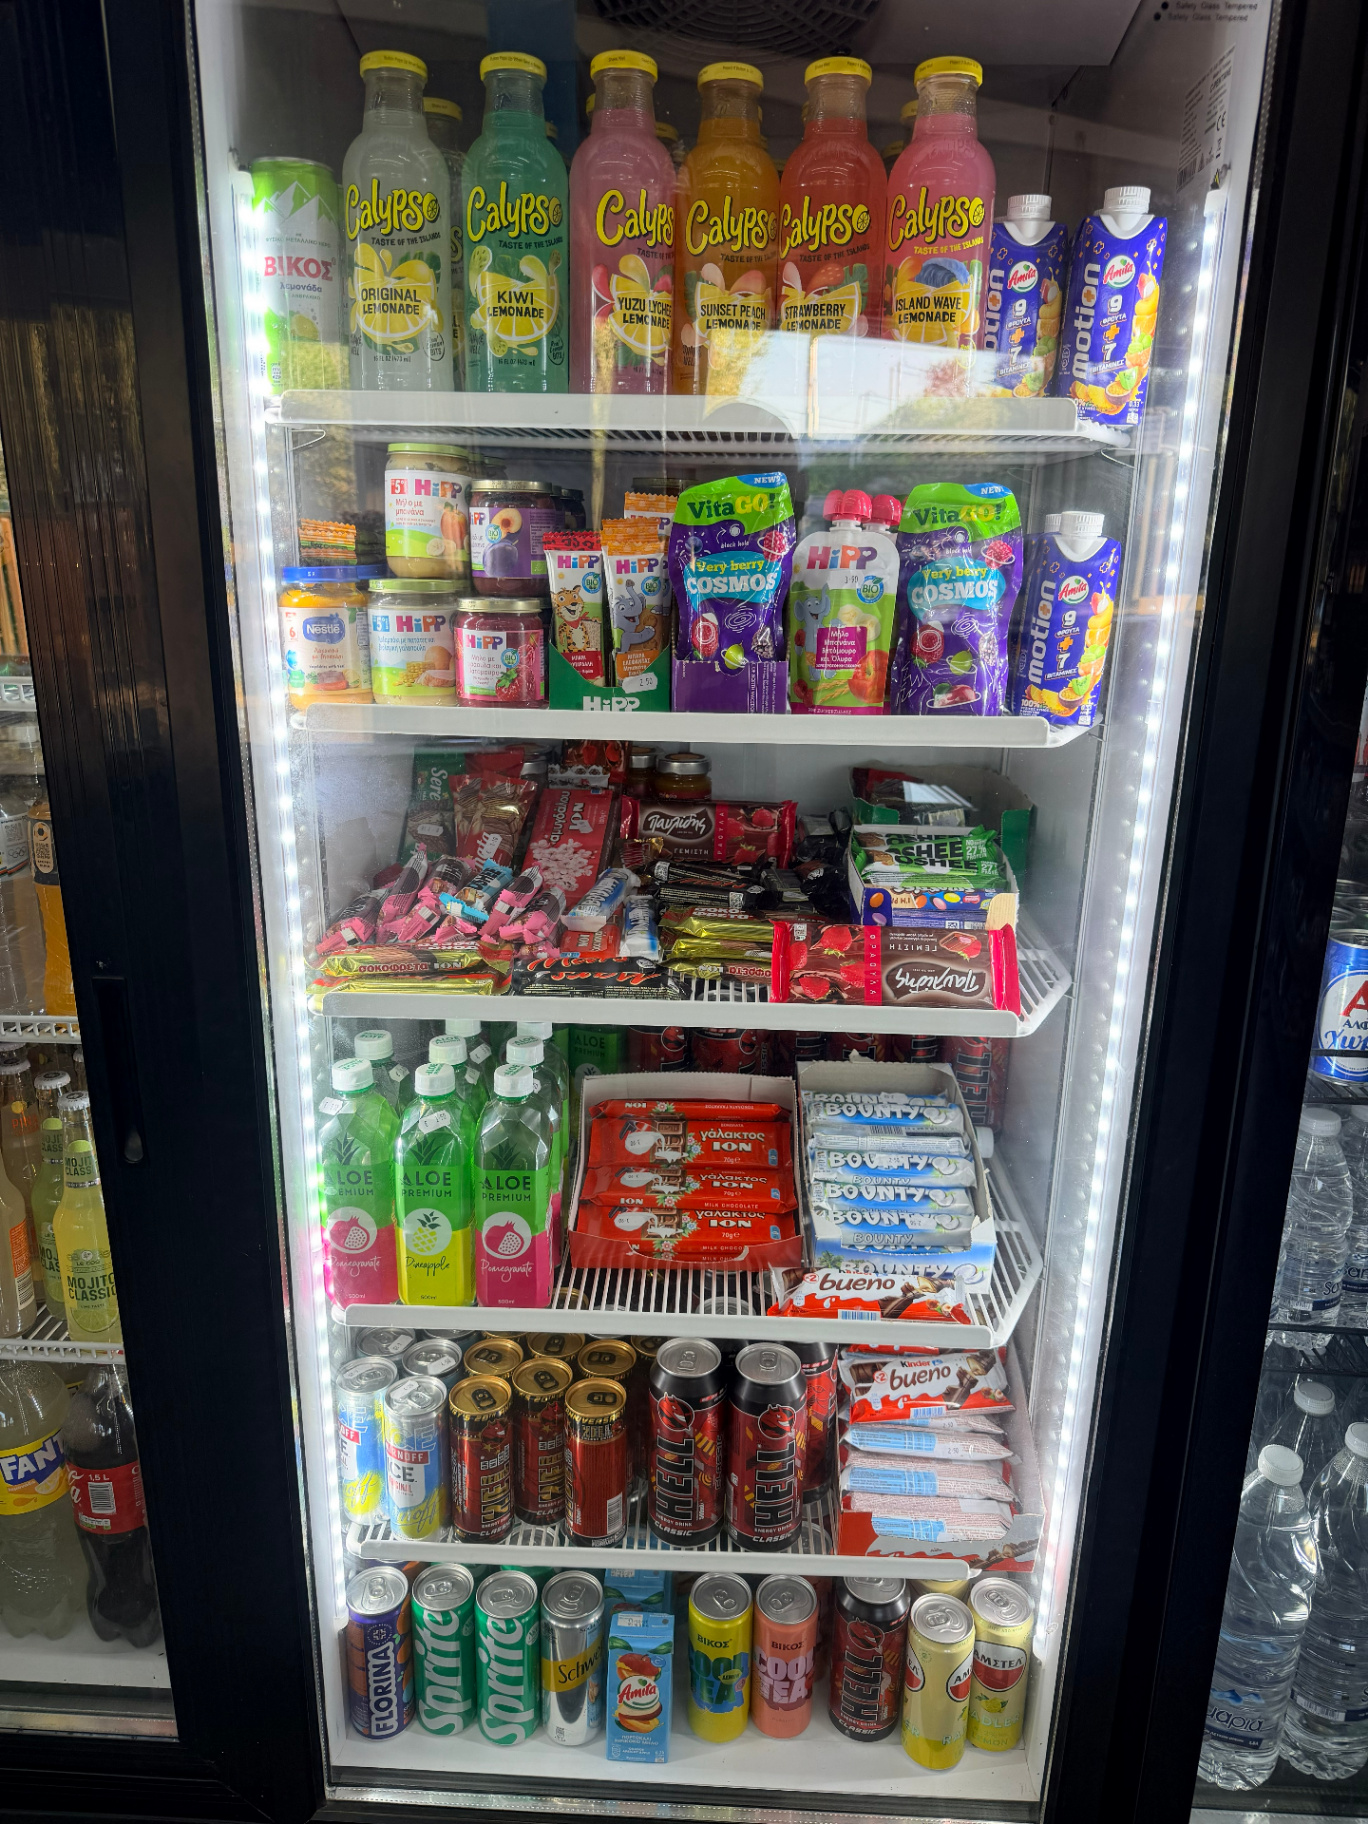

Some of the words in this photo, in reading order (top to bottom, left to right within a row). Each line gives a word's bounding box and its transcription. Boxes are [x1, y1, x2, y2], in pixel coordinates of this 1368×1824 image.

[1225, 1, 1257, 10] Tempered
[346, 179, 441, 241] Calypso
[466, 181, 563, 242] Calypso
[596, 188, 674, 247] Calyps
[888, 186, 985, 251] Calypso
[779, 195, 871, 259] Calypso
[371, 236, 395, 246] TASTE
[408, 237, 418, 245] THE
[499, 240, 523, 250] TASTE
[913, 245, 937, 255] TASTE
[938, 244, 948, 253] OF
[950, 243, 961, 252] THE
[961, 236, 984, 251] ISLANDS
[799, 254, 821, 263] TASTE
[264, 256, 333, 281] ΒΙΚΟΣ
[1103, 262, 1134, 285] Amita
[1007, 267, 1038, 290] Amita
[280, 281, 322, 293] λεμονάδα
[361, 288, 421, 303] ORIGINAL
[497, 291, 534, 304] KIWI
[363, 303, 420, 315] LEMONADE
[618, 297, 646, 311] YUZU
[648, 299, 672, 318] LYCHEE
[700, 303, 737, 318] SUNSET
[740, 305, 766, 319] PEACH
[784, 303, 846, 319] STRAWBERRY
[895, 296, 930, 312] ISLAND
[933, 296, 962, 311] WAVE
[1013, 299, 1027, 318] 9
[1109, 295, 1123, 315] 9
[488, 306, 544, 319] LEMONADE
[898, 311, 956, 325] LEMONADE
[1101, 313, 1127, 327] ΦΡΟΥΤΑ
[622, 313, 670, 330] LEMONADE
[706, 319, 761, 331] LEMONADE
[786, 319, 841, 331] LEMONADE
[1007, 316, 1031, 328] ΦΡΟΥΤΑ
[1072, 263, 1100, 380] motion
[1010, 345, 1021, 366] 7
[1104, 343, 1117, 363] 7
[1092, 360, 1125, 374] ΒΙΤΑΜΙΝΕΣ
[415, 479, 462, 499] HiPP
[980, 486, 1004, 495] NEW!
[396, 508, 424, 516] μπανάνα
[687, 493, 776, 519] VitaGO!
[913, 503, 1001, 526] VitaGO!
[557, 555, 600, 569] HiPP
[807, 546, 878, 570] HiPP
[616, 558, 659, 575] HiPP
[696, 560, 727, 573] Very
[730, 560, 765, 571] berry
[922, 567, 950, 580] Very
[955, 564, 986, 579] berry
[586, 578, 598, 586] BIO
[645, 582, 658, 590] BIO
[687, 573, 778, 595] COSMOS
[861, 584, 879, 594] BIO
[912, 580, 998, 603] COSMOS
[1058, 581, 1087, 601] Amita
[396, 615, 446, 632] HiPP
[1063, 610, 1077, 627] 9
[289, 627, 296, 638] 6
[831, 630, 849, 638] Μήλο
[1028, 580, 1056, 684] motion
[1055, 627, 1080, 637] ΦΡΟΥΤΑ
[465, 634, 504, 650] HiPP
[1058, 653, 1070, 671] 7
[1045, 668, 1078, 680] ΒΙΤΑΜΙΝΕΣ
[583, 696, 640, 711] HiPP
[647, 812, 706, 840] Παυλίδης
[674, 847, 710, 856] ΓΕΜΙΣΤΗ
[895, 856, 978, 869] OSHEE
[889, 943, 937, 951] ΓΕΜΙΣΤΗ
[896, 967, 980, 994] Παυλίδης
[1343, 1018, 1368, 1031] ΑΛΦ
[574, 1035, 605, 1047] ALOE
[826, 1102, 921, 1120] BOUNTY
[700, 1128, 765, 1142] γάλακτος
[712, 1142, 752, 1152] ION
[65, 1156, 93, 1167] MOJIT
[400, 1171, 451, 1187] ALOE
[479, 1175, 531, 1191] ALOE
[700, 1174, 768, 1183] γάλακτος
[712, 1181, 753, 1189] ION
[853, 1174, 911, 1185] BOUNTY
[402, 1188, 452, 1198] PREMIUM
[482, 1193, 531, 1202] PREMIUM
[828, 1182, 928, 1202] BOUNTY
[709, 1218, 752, 1228] ION
[853, 1232, 913, 1245] BOUNTY
[406, 1255, 450, 1277] Pineapple
[481, 1259, 533, 1283] Pomegranate
[841, 1260, 949, 1278] BOUNTY
[819, 1273, 895, 1291] bueno
[889, 1366, 951, 1391] bueno
[656, 1434, 695, 1521] HELL
[755, 1440, 796, 1528] HELL
[655, 1521, 692, 1537] CLASSIC
[752, 1532, 793, 1543] CLASSIC
[697, 1634, 729, 1648] ΒΙΚΟΣ
[771, 1641, 804, 1650] ΒΙΚΟΣ
[558, 1646, 601, 1684] Schwe
[755, 1646, 814, 1681] COOL
[974, 1649, 1023, 1669] ΑΜΣΤΕΛ
[419, 1608, 472, 1736] Sprite
[370, 1643, 396, 1734] FLORINA
[478, 1617, 535, 1745] Sprite
[840, 1651, 884, 1722] HELL
[618, 1683, 657, 1703] Amita
[759, 1677, 808, 1704] TEA
[838, 1719, 878, 1736] CLASSIC
[972, 1733, 1008, 1746] LEMON
